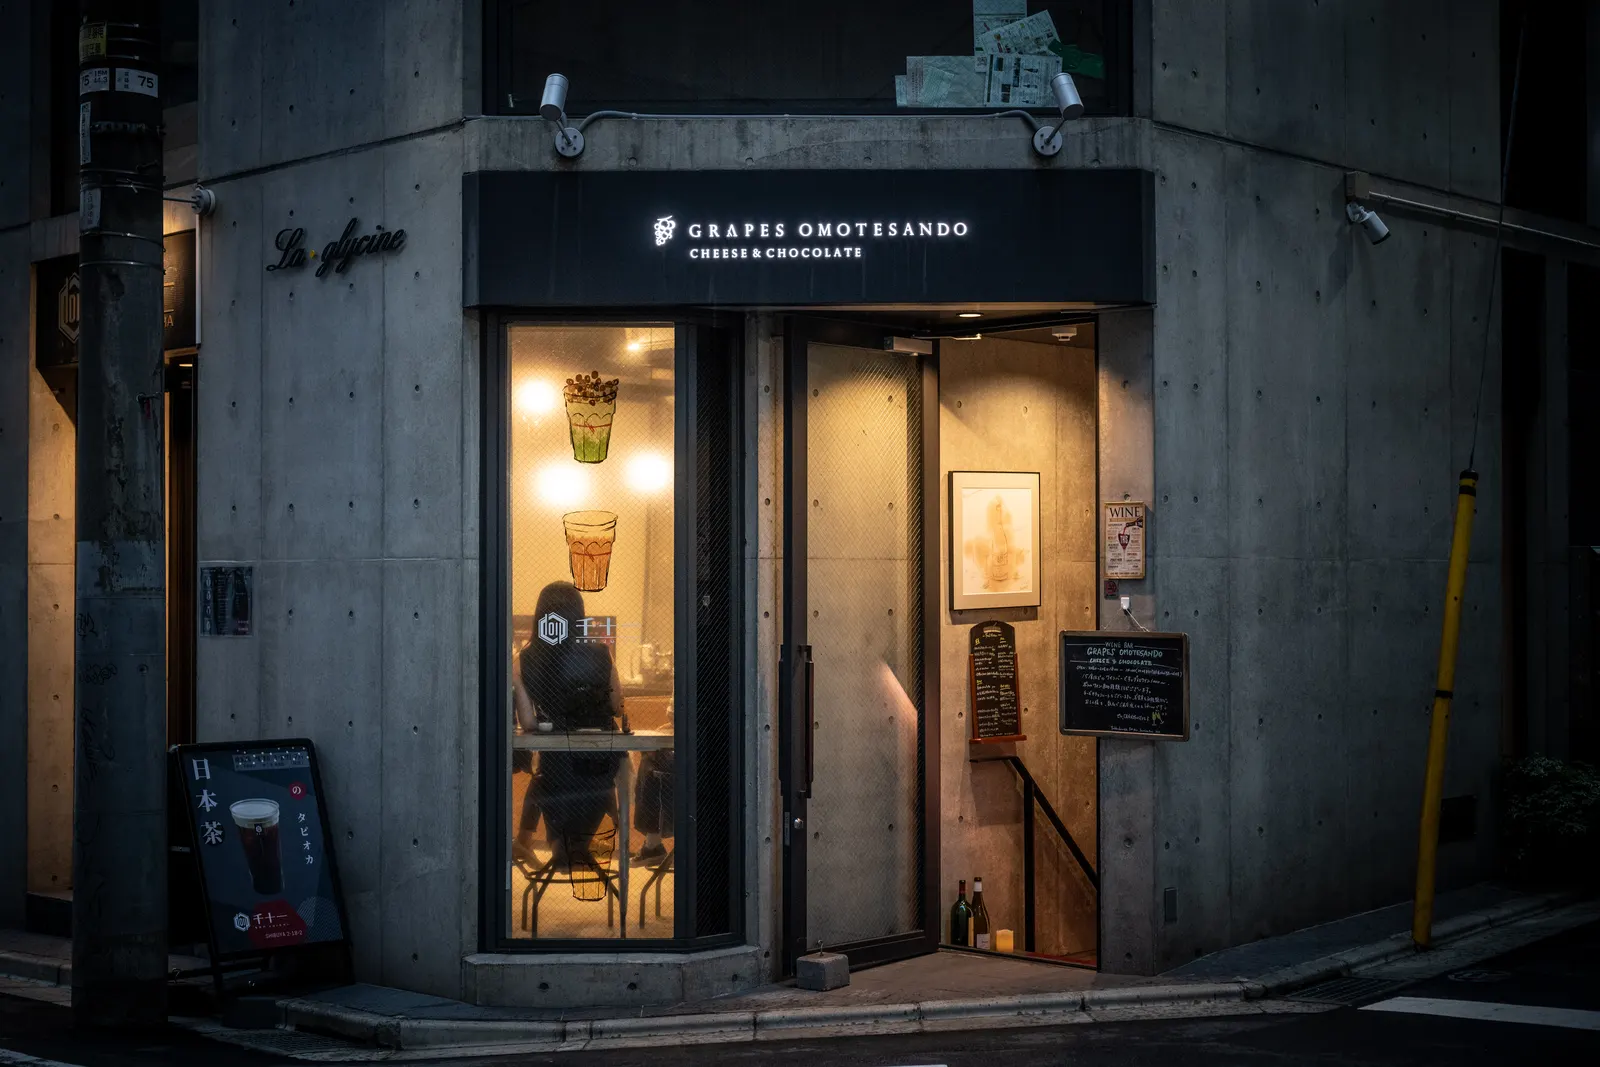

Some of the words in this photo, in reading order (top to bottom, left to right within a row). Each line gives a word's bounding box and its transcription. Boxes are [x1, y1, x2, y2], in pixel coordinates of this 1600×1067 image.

[137, 75, 154, 89] 75
[688, 222, 785, 238] GRAPES
[798, 222, 968, 237] OMOTESANDO
[266, 228, 306, 271] La
[315, 217, 405, 277] glycine
[1109, 506, 1140, 518] WINE
[1086, 646, 1116, 656] GRAPES
[1119, 648, 1164, 658] OMOTESANDO
[292, 785, 302, 796] の
[192, 757, 225, 845] 日本茶
